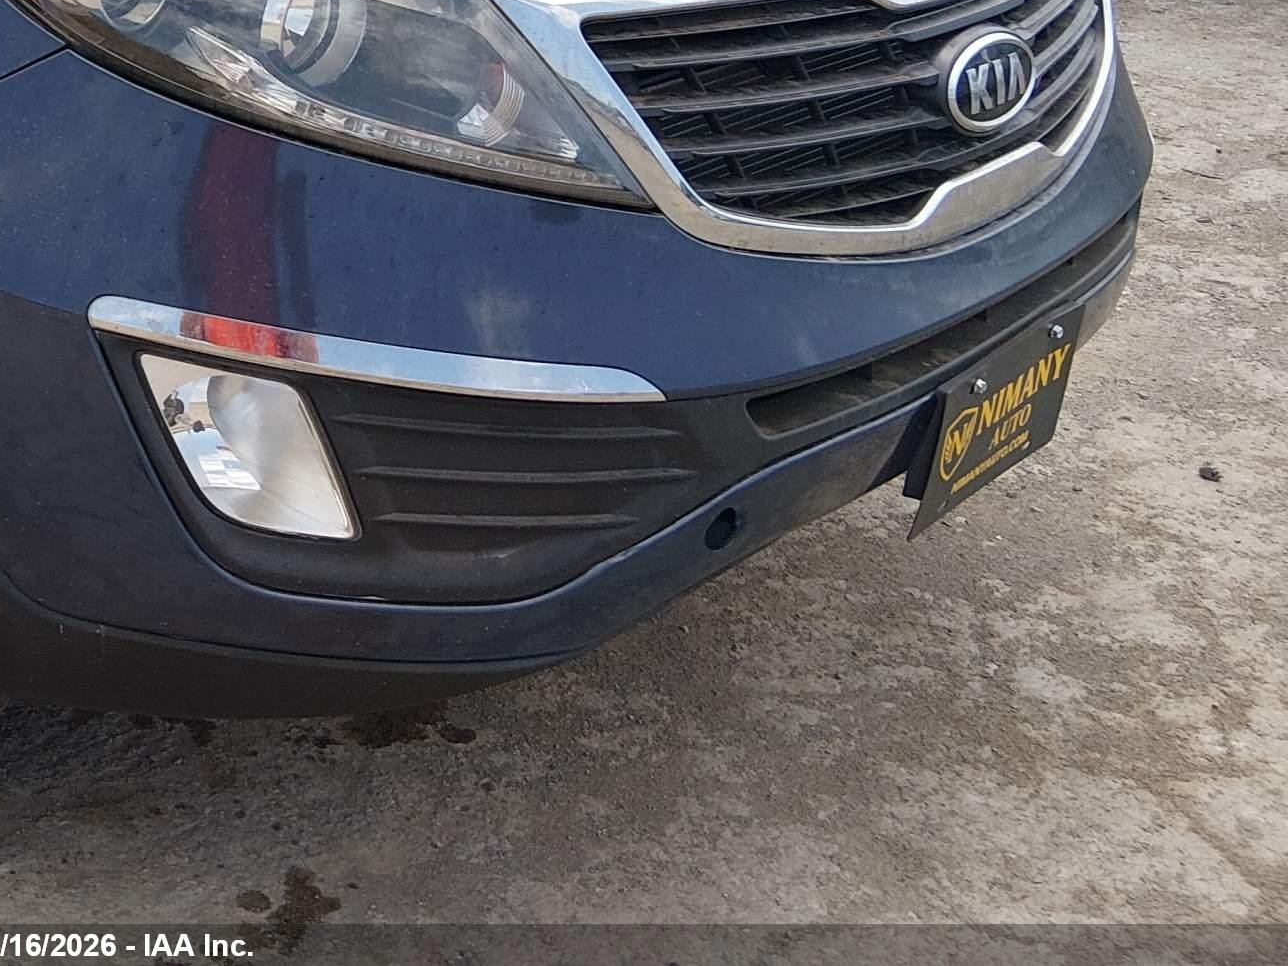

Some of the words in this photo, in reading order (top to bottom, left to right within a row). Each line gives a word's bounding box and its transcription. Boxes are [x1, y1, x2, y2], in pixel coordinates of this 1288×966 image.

[965, 52, 1027, 115] KIA
[975, 343, 1072, 436] NIMANY
[988, 403, 1032, 451] AUTO
